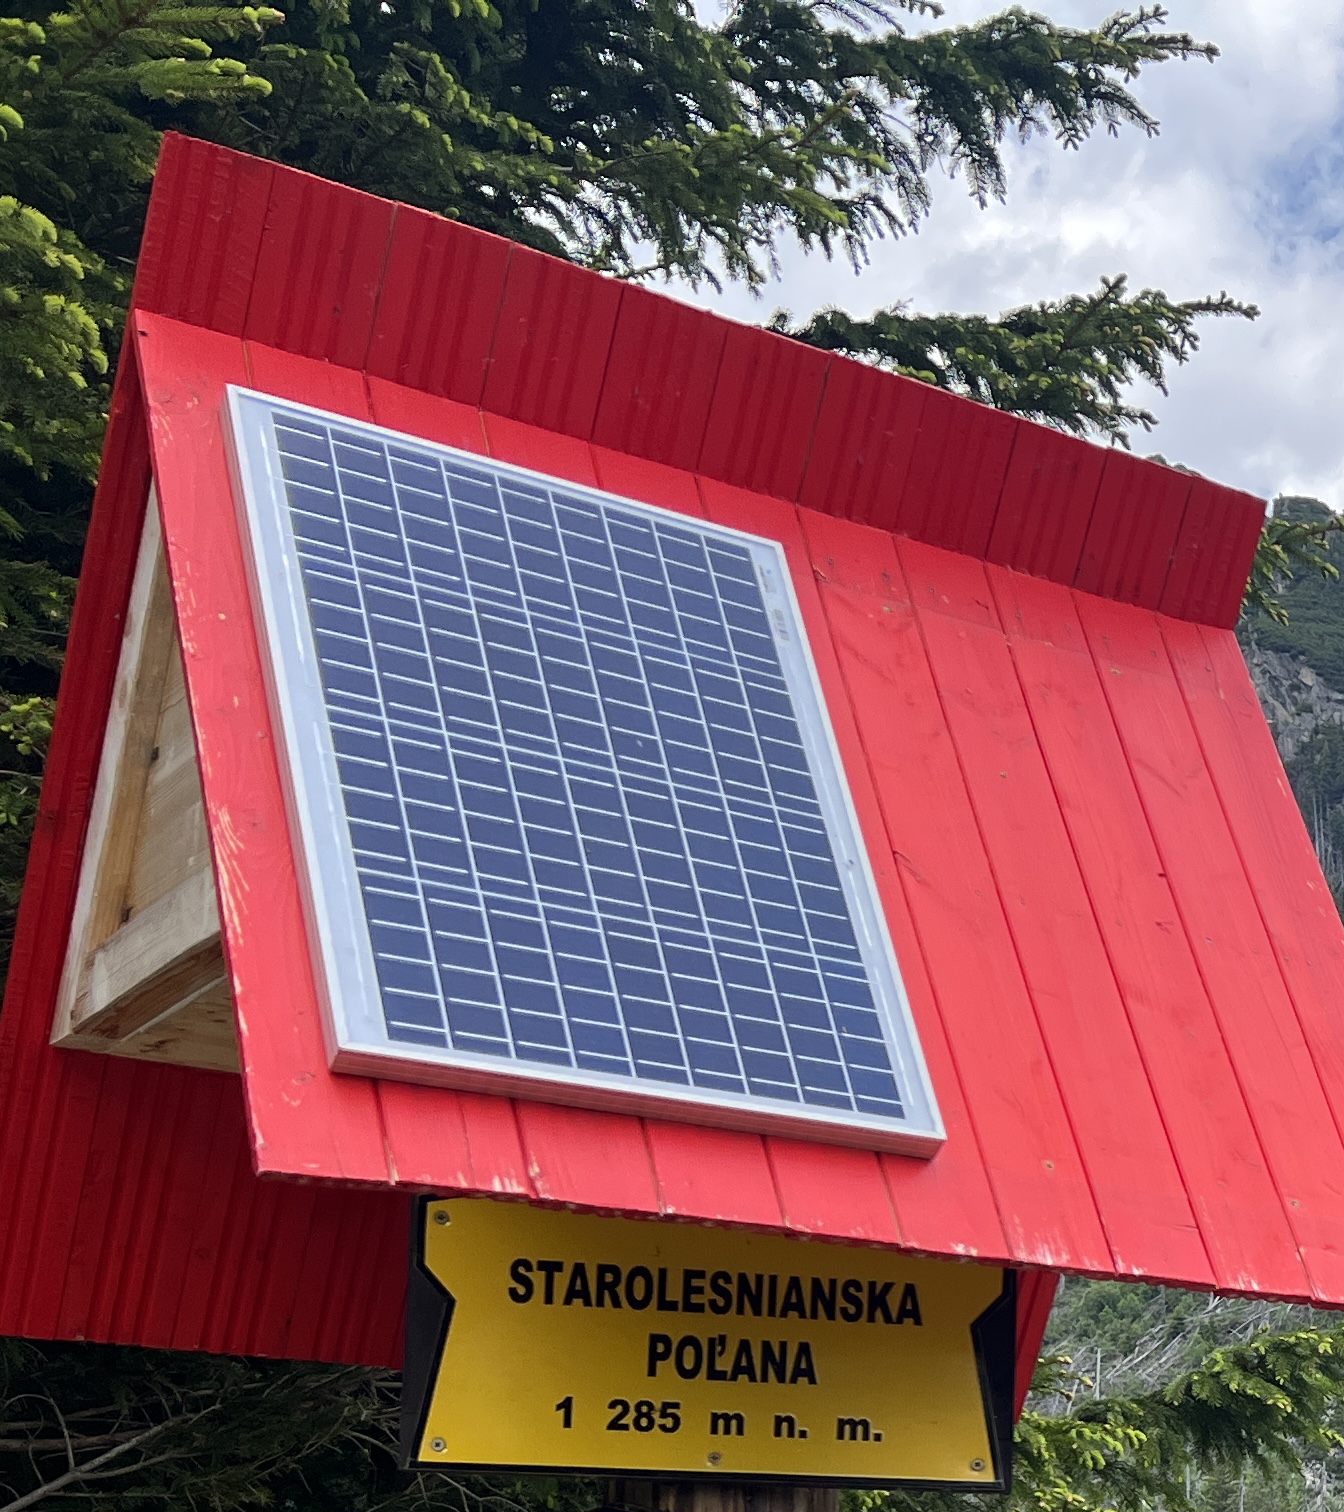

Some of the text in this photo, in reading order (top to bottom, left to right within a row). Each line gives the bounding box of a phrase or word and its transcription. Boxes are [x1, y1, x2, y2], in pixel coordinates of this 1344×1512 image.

[509, 1259, 923, 1326] STAROLESNIANSKA
[648, 1333, 817, 1385] POĽANA
[556, 1397, 882, 1442] 1 285 m n. m.
